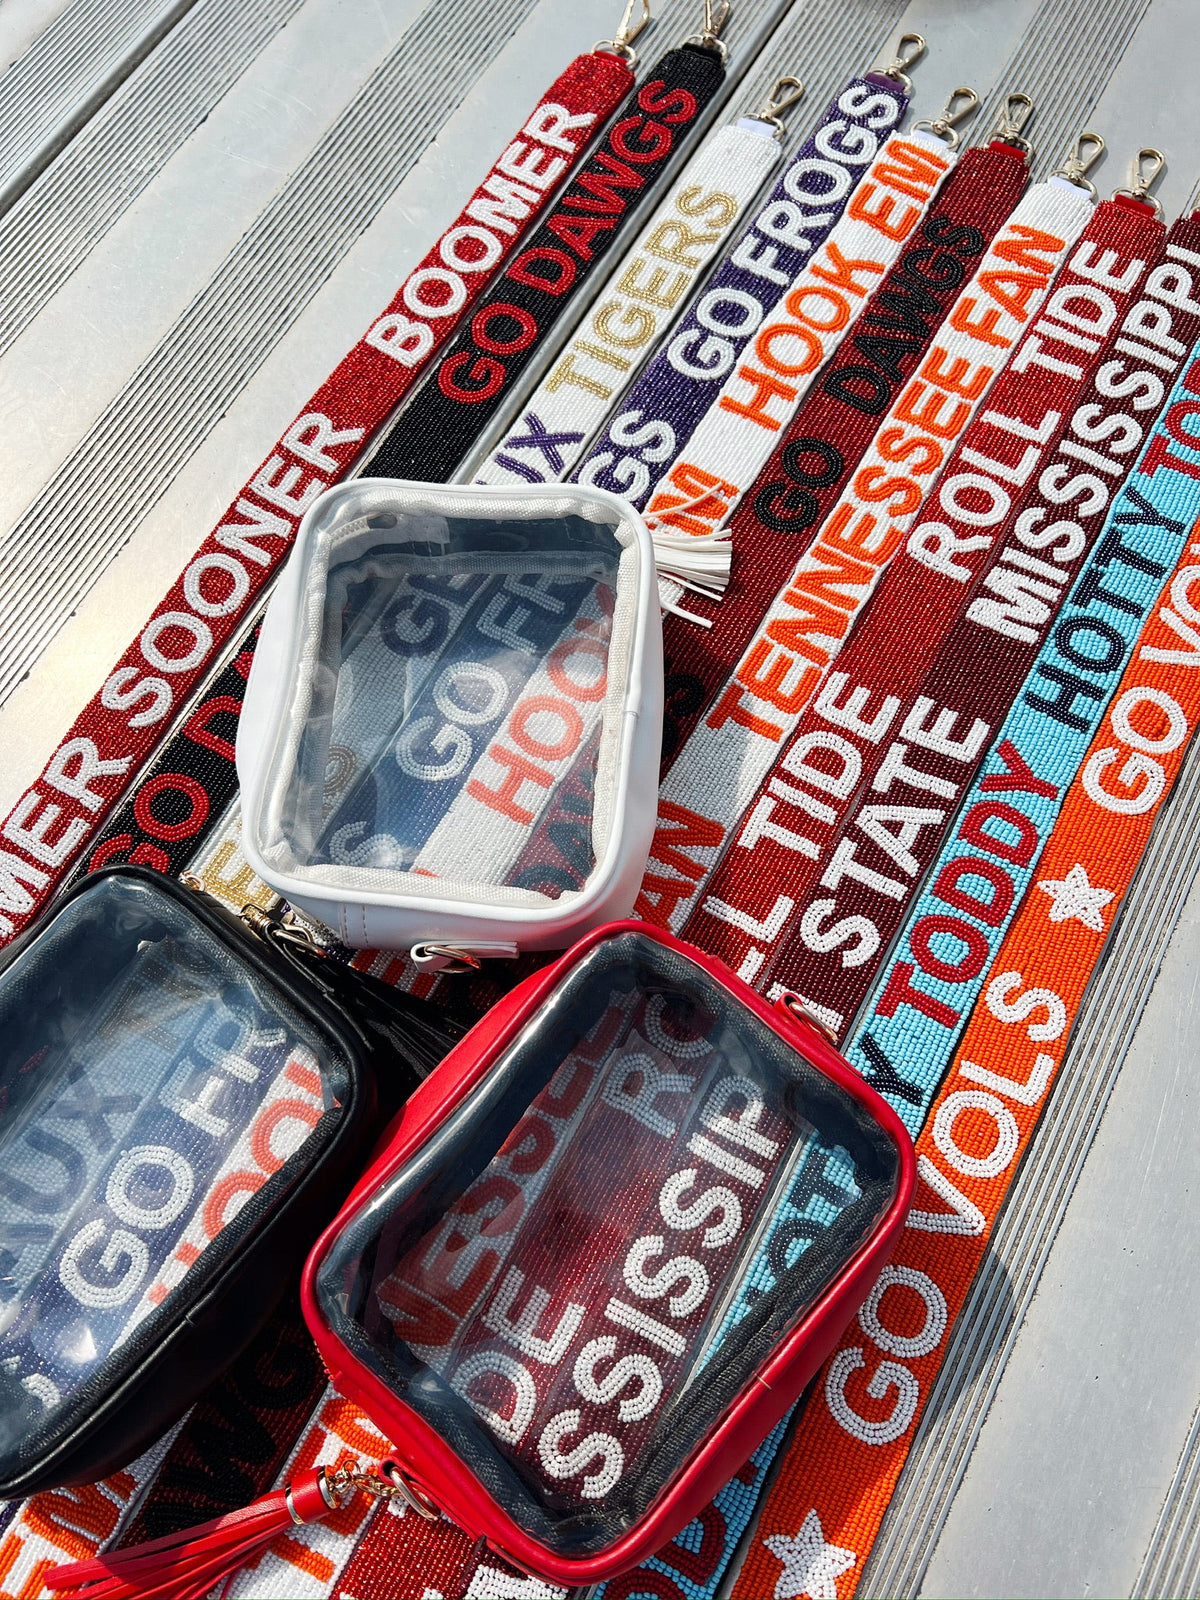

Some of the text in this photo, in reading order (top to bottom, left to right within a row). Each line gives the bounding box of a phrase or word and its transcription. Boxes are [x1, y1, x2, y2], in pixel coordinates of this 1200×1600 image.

[365, 101, 597, 368] BOOMER
[437, 303, 538, 405] GO
[505, 80, 698, 296] DAWGS
[545, 185, 737, 401] TIGERS
[667, 85, 902, 382] GO FROGS
[719, 139, 950, 432] HOOK EM
[706, 345, 995, 742] TENNESSEE
[949, 224, 1067, 348] FAN
[753, 217, 985, 534] GO DAWGS
[906, 240, 1146, 584] ROLL TIDE
[101, 412, 366, 728] SOONER
[1024, 485, 1187, 734] HOTTY
[396, 661, 509, 782] GO
[737, 671, 902, 861] TIDE
[800, 694, 991, 969] STATE
[1082, 686, 1188, 816] GO
[875, 738, 1060, 1029] TODDY
[59, 1144, 194, 1308] GO
[905, 970, 1067, 1236] VOLS
[825, 1265, 947, 1445] GO
